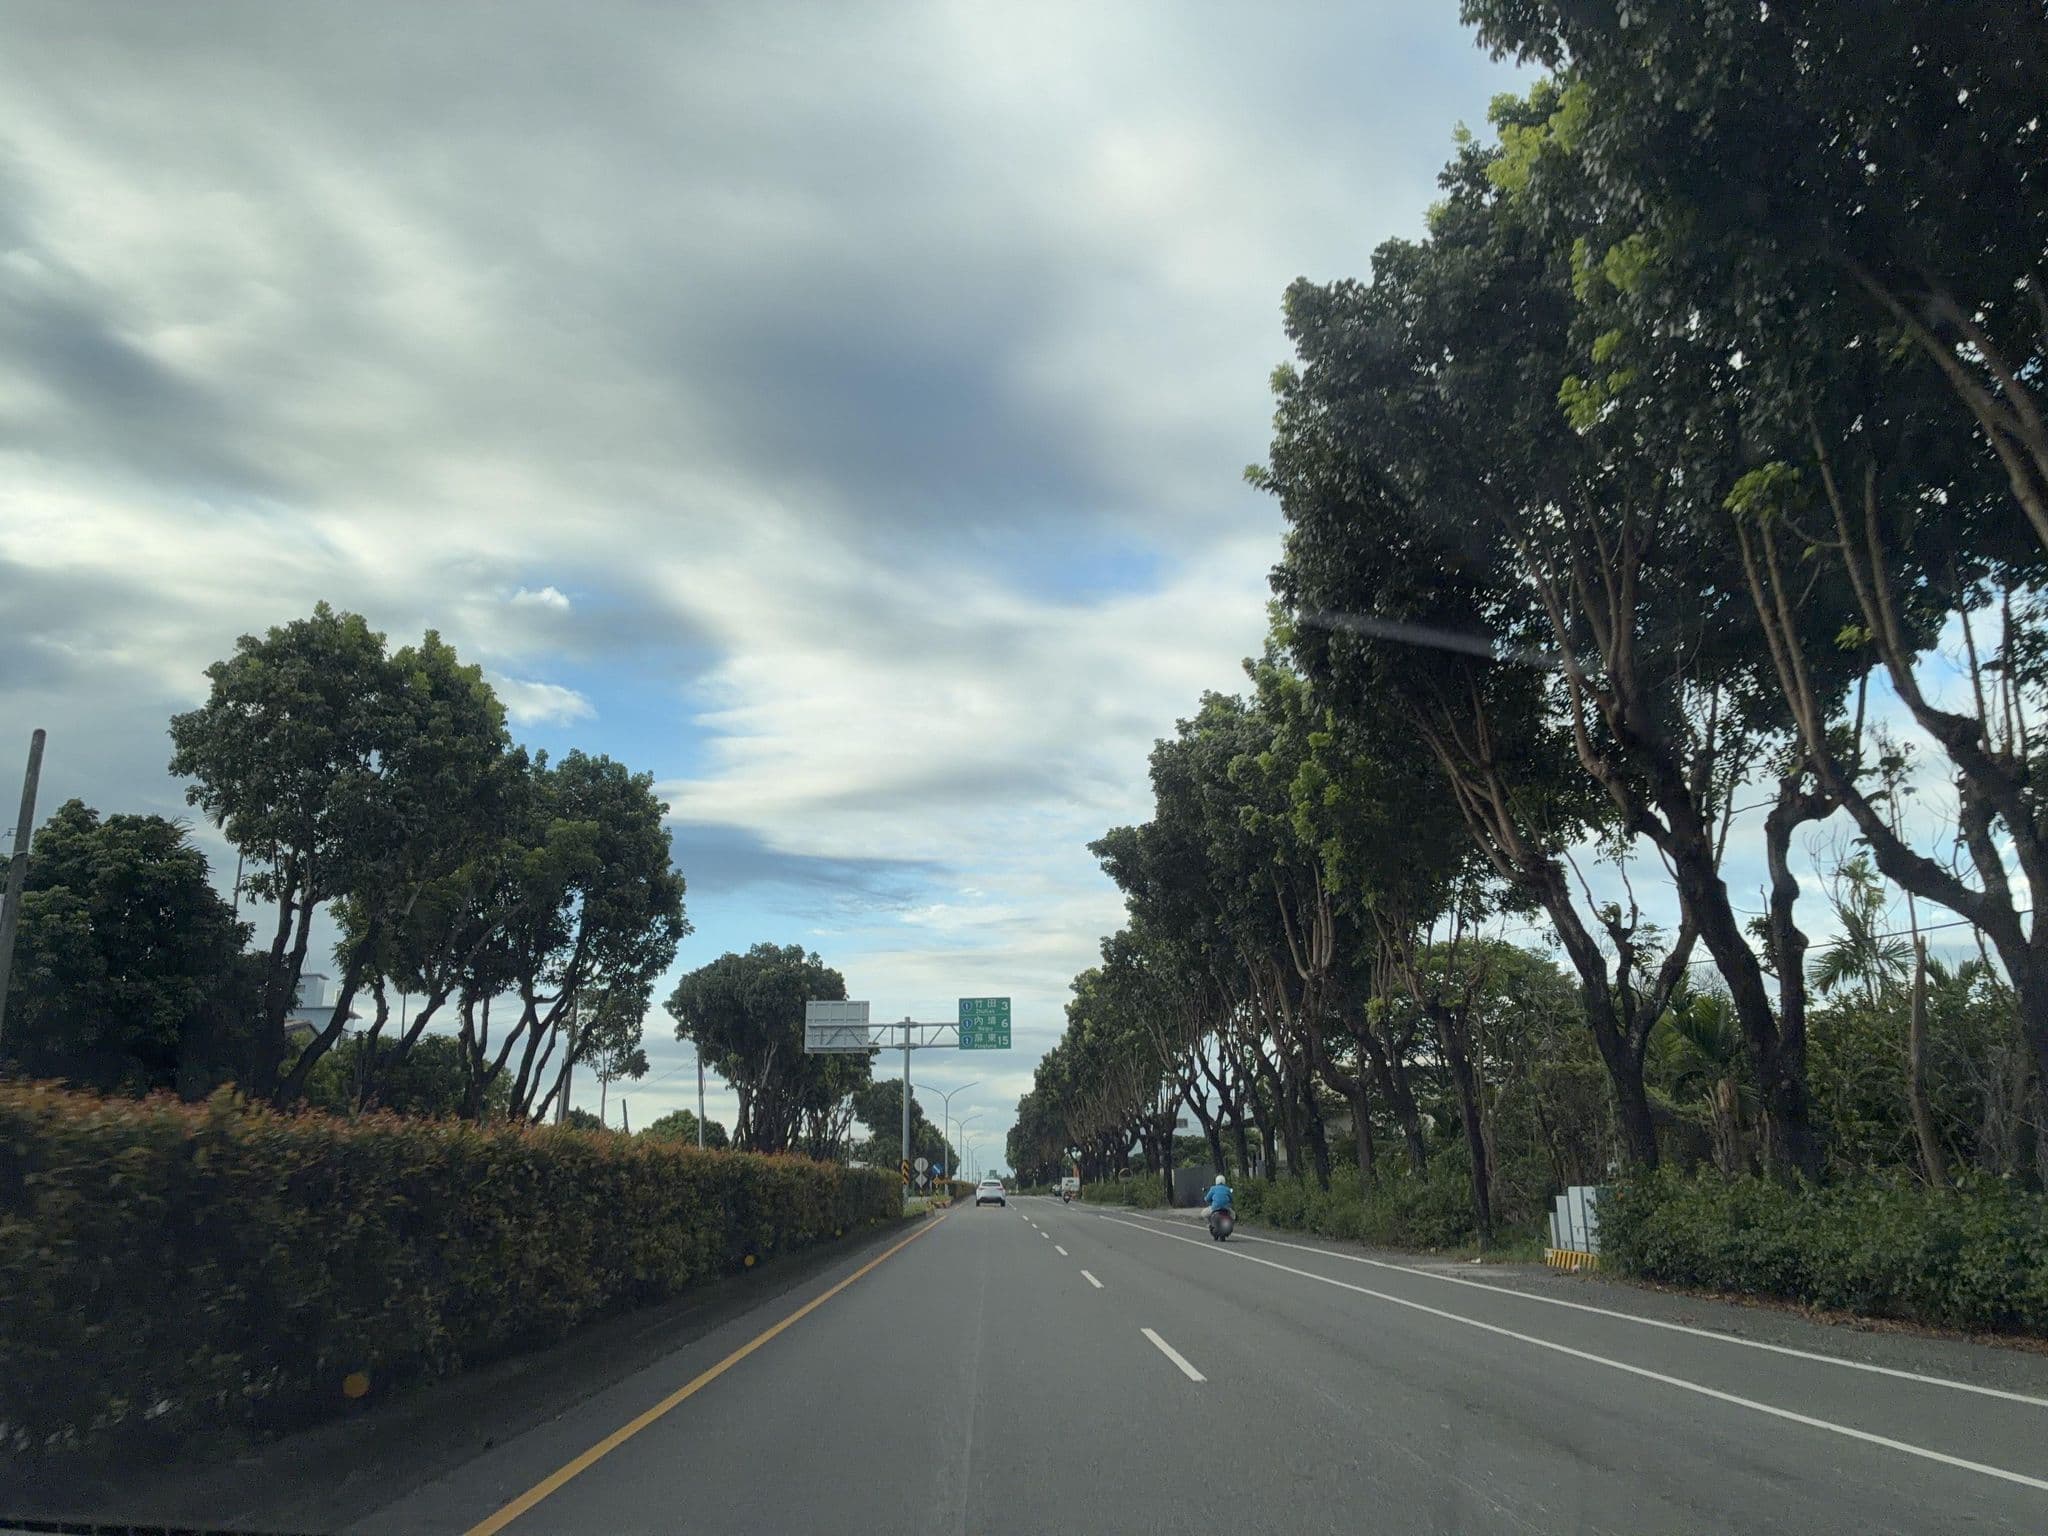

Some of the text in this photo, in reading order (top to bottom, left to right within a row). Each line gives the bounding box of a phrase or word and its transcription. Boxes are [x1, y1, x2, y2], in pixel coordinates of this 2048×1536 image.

[1001, 1001, 1008, 1011] 3
[1001, 1018, 1008, 1028] 6
[998, 1036, 1008, 1046] 15
